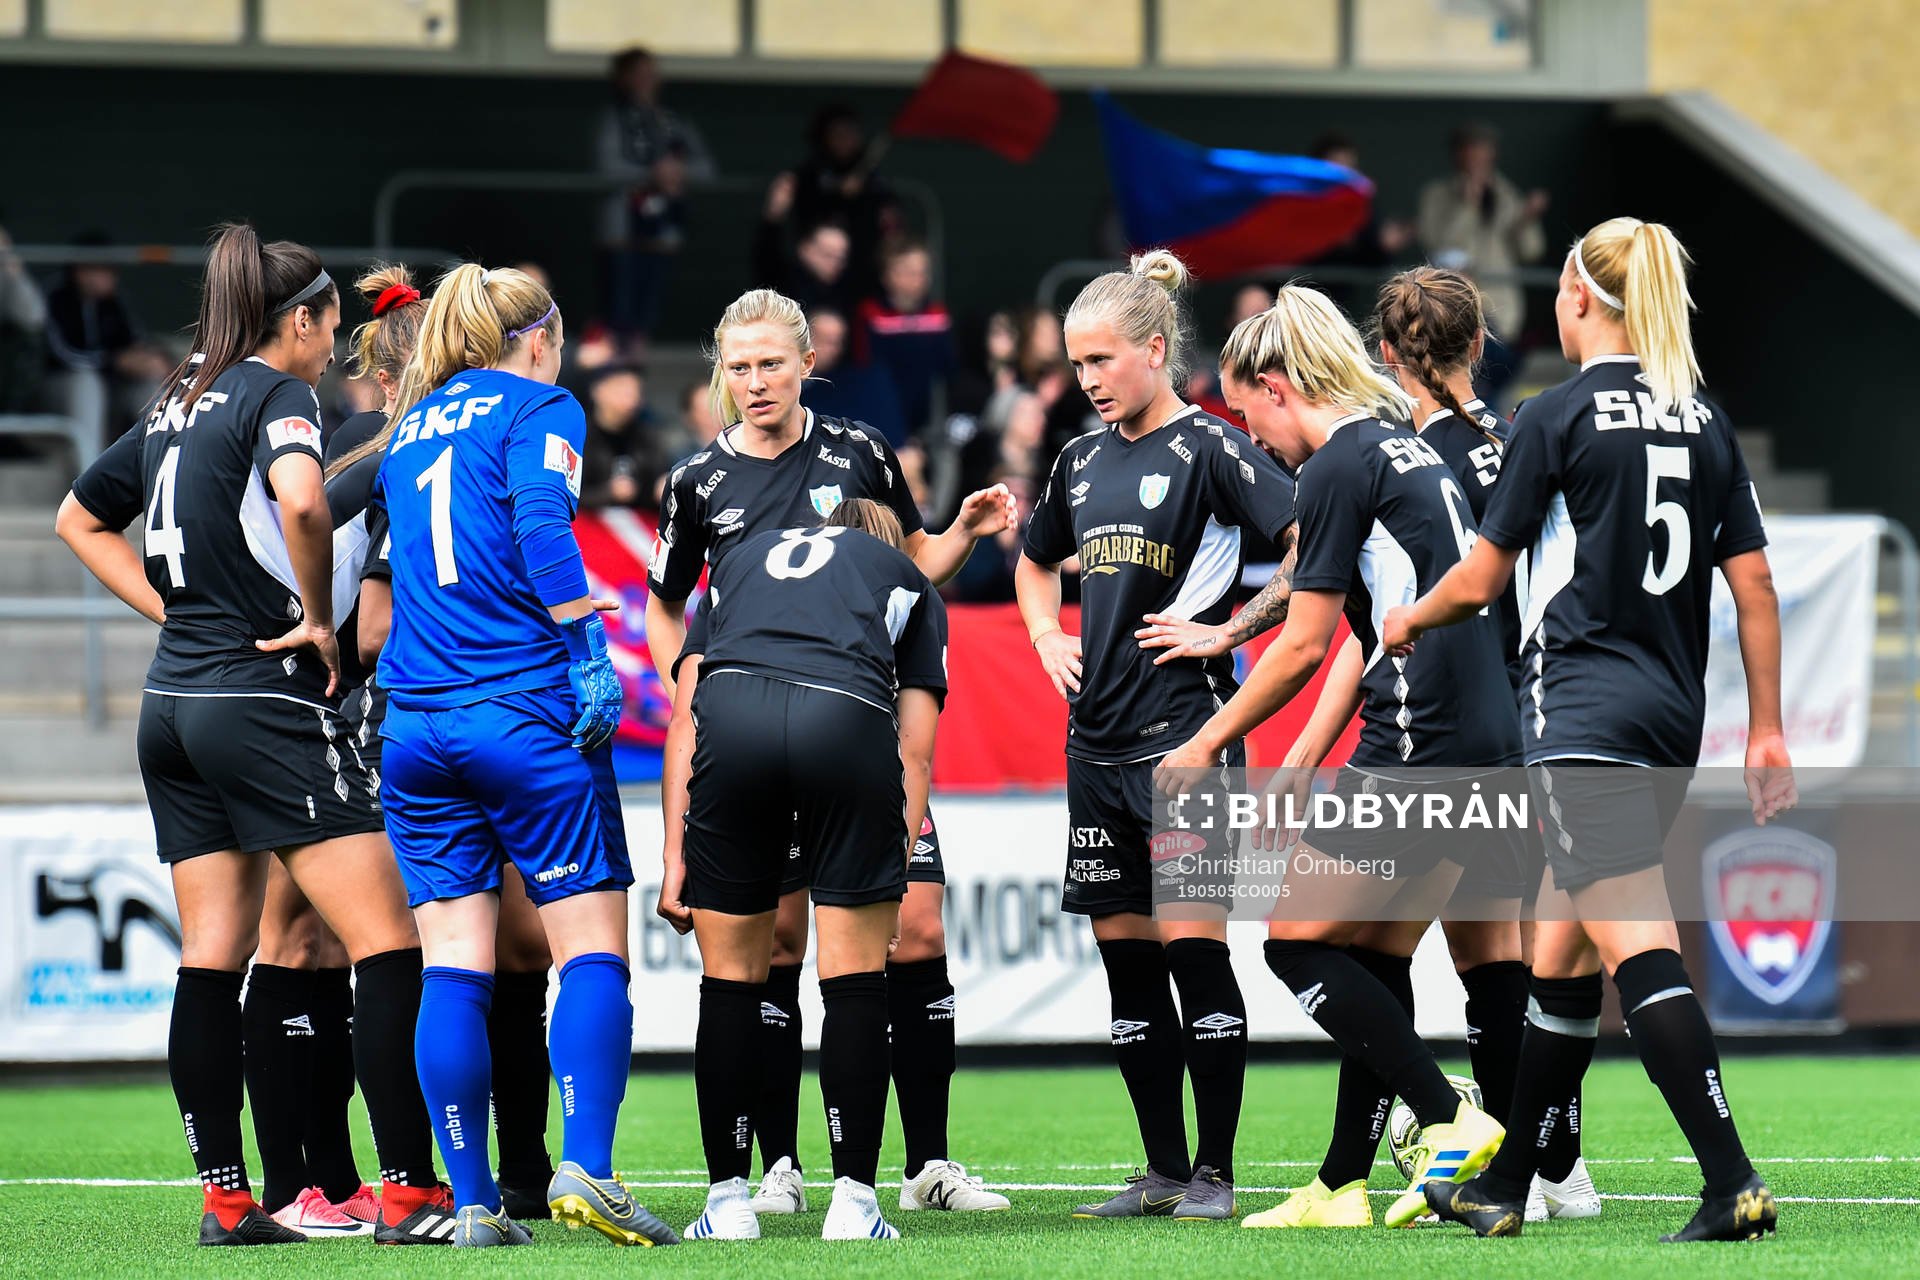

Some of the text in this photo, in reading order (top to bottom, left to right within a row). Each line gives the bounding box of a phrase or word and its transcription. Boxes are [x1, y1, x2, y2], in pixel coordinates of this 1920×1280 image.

[146, 392, 229, 437] SKF
[390, 394, 504, 455] SKF
[1594, 390, 1713, 434] SKF
[817, 445, 851, 469] RASTA
[1167, 433, 1194, 464] RASTA
[696, 469, 728, 499] RASTA
[145, 445, 186, 588] 4
[415, 445, 460, 588] 1
[718, 521, 745, 535] umbro
[1083, 523, 1144, 541] PREMIUM CIDER
[1641, 444, 1692, 596] 5
[765, 526, 848, 580] 8
[1080, 535, 1176, 579] PPARBERG
[1071, 827, 1115, 848] ASTA
[535, 862, 580, 883] umbro
[1159, 876, 1185, 886] umbro
[928, 1011, 954, 1020] umb
[1195, 1030, 1242, 1040] umbro
[1111, 1033, 1146, 1046] mbro
[562, 1075, 576, 1117] umbro
[1705, 1068, 1730, 1119] umbro
[184, 1112, 199, 1154] umbro
[445, 1104, 465, 1150] umbro
[731, 1115, 748, 1149] umbro
[828, 1107, 843, 1142] umbro
[1369, 1097, 1389, 1141] umbro
[1536, 1106, 1561, 1149] umbro
